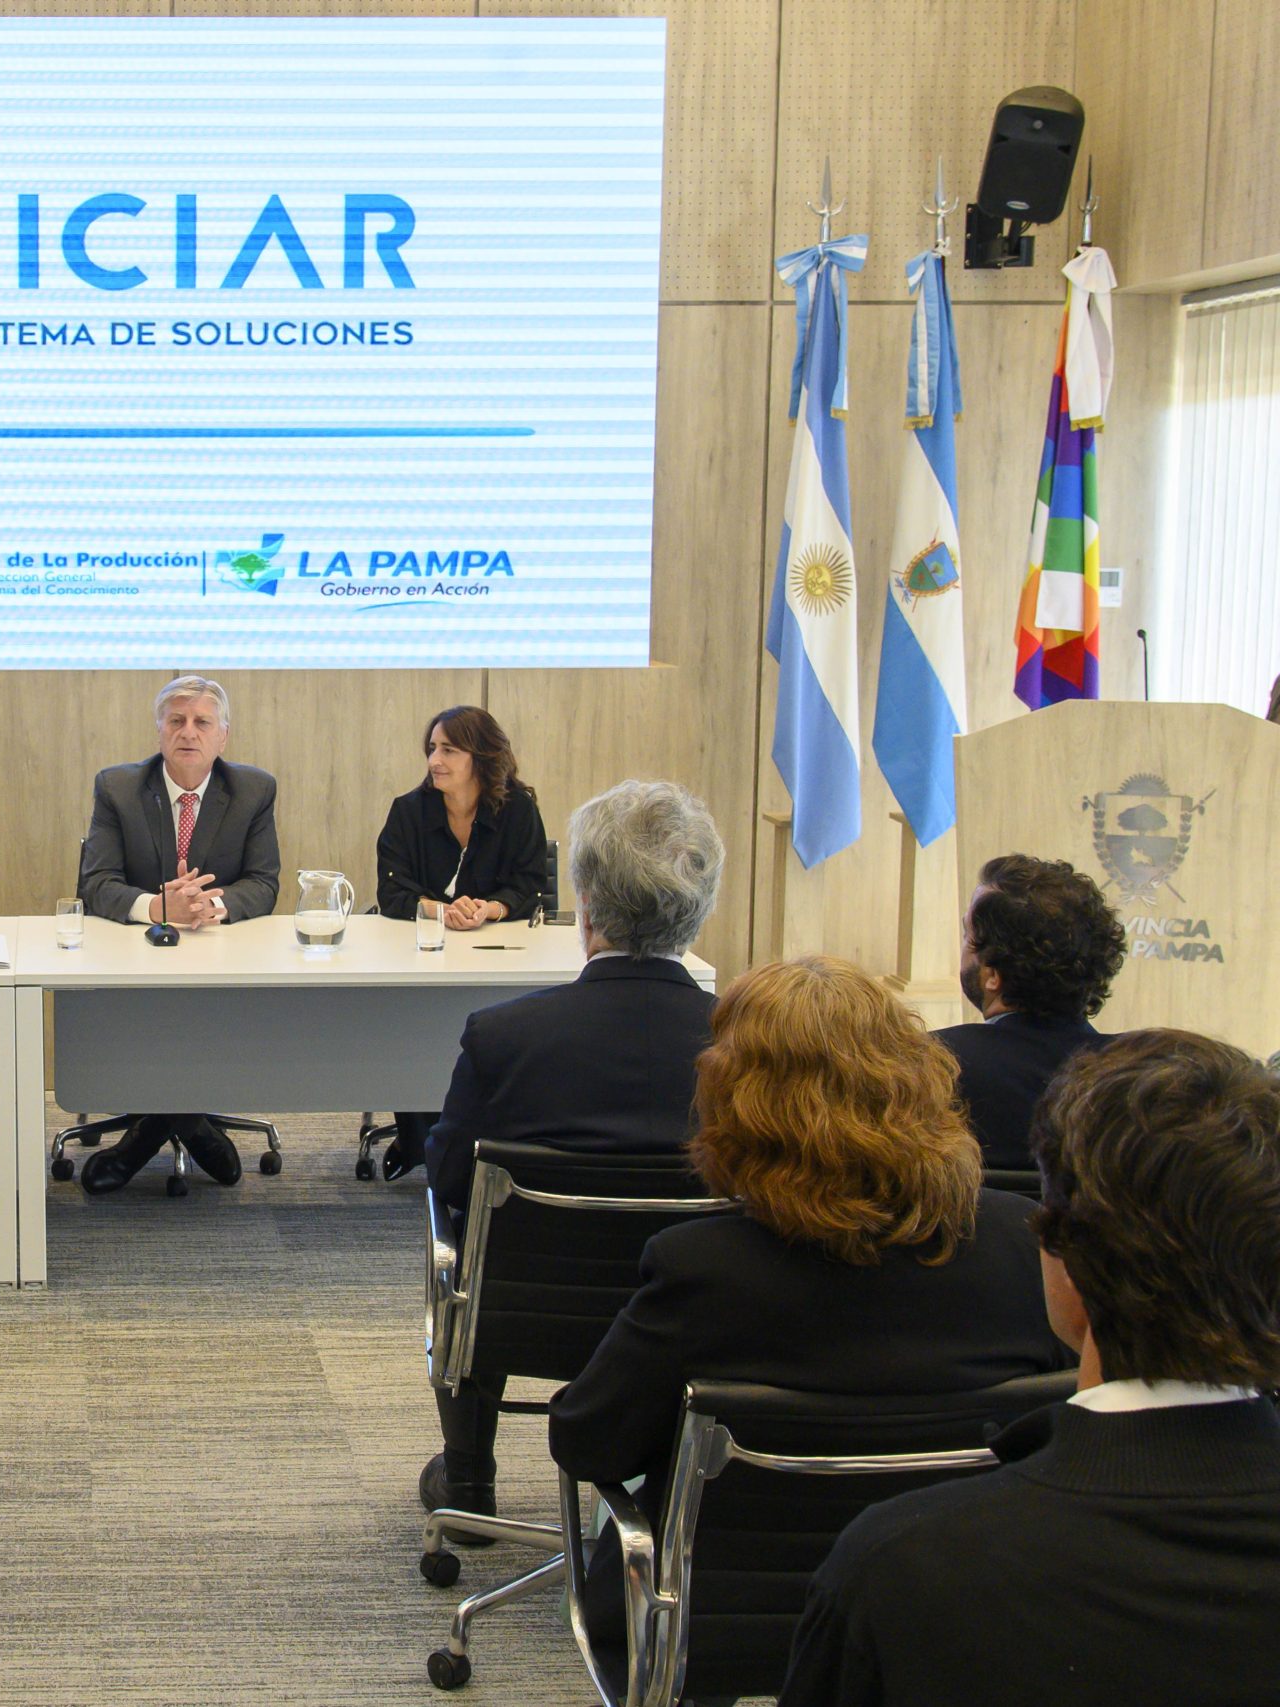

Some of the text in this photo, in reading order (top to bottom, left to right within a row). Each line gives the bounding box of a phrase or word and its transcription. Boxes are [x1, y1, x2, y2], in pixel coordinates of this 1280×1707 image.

[110, 321, 157, 346] DE
[171, 321, 415, 346] SOLUCIONES
[7, 552, 35, 568] de
[43, 552, 68, 568] La
[77, 552, 199, 568] Producción
[298, 550, 514, 577] LA PAMPA
[44, 571, 96, 583] General
[22, 583, 41, 596] del
[46, 583, 140, 596] Conocimiento
[320, 581, 490, 597] Gobierno en Acción
[1122, 917, 1210, 938] VINCIA
[1131, 940, 1224, 963] PAMPA
